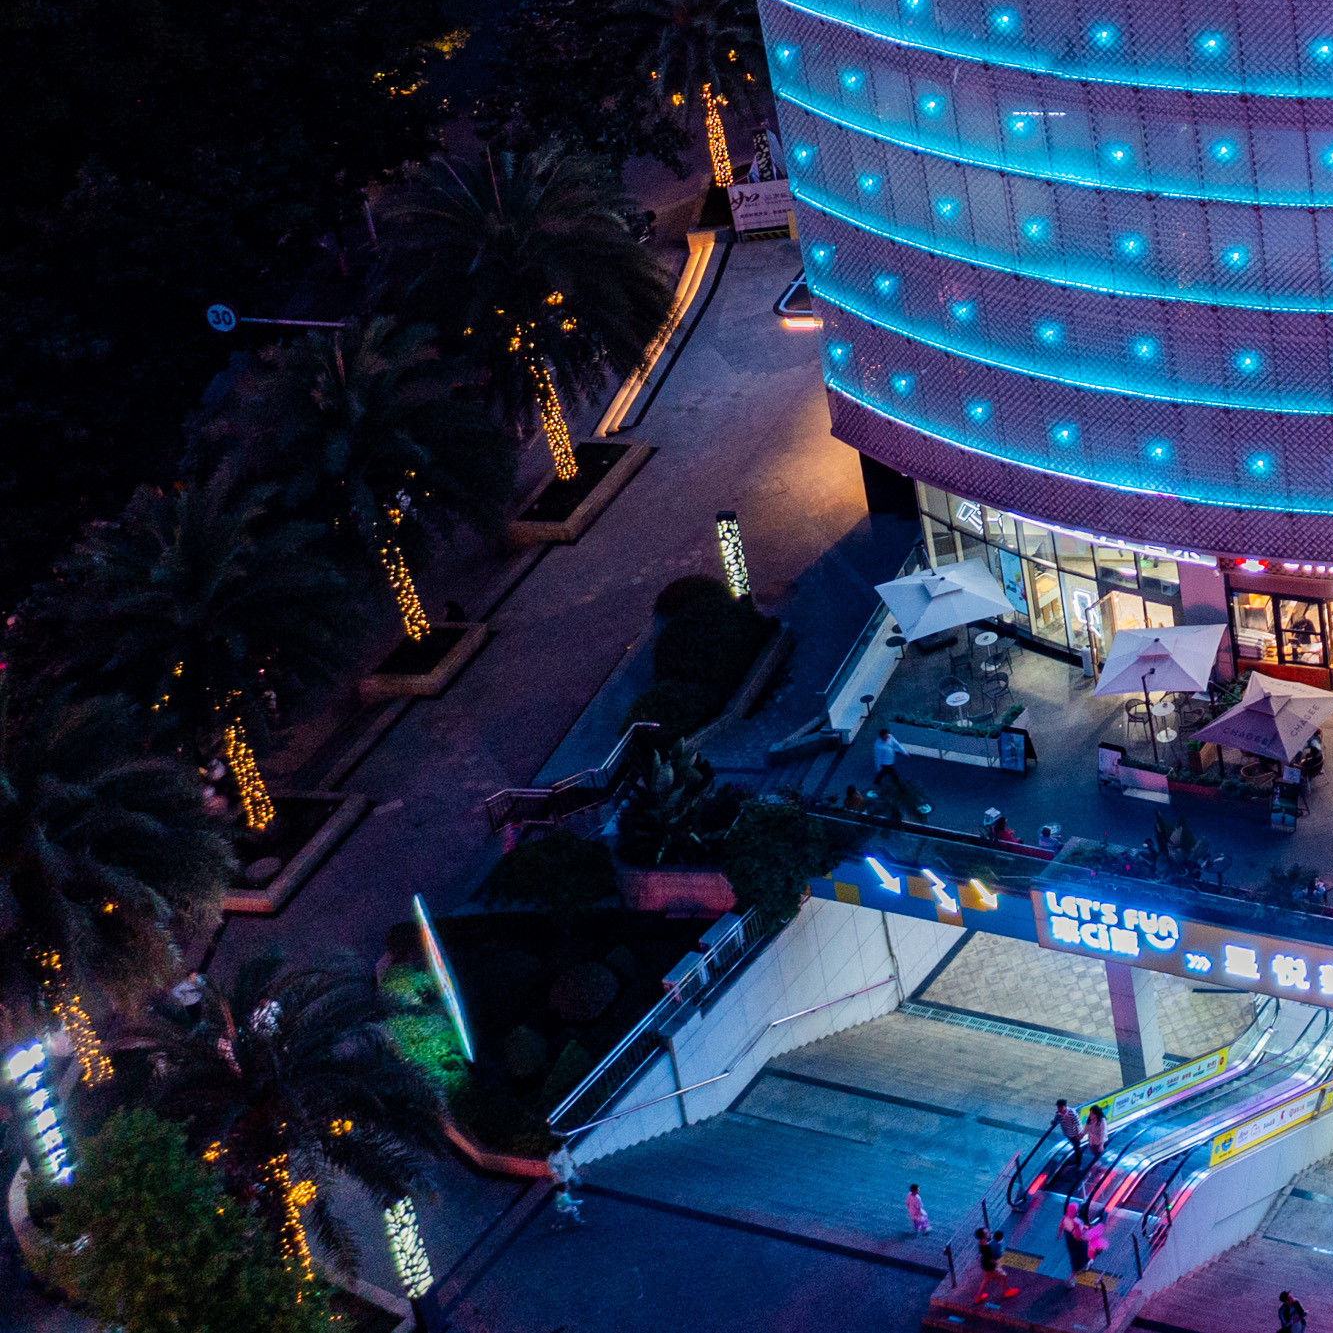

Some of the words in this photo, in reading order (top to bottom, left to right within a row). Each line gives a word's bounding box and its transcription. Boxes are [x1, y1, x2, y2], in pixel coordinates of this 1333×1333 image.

[211, 310, 232, 325] 30
[1290, 704, 1320, 738] CHAGEE
[1046, 891, 1118, 925] LET'S
